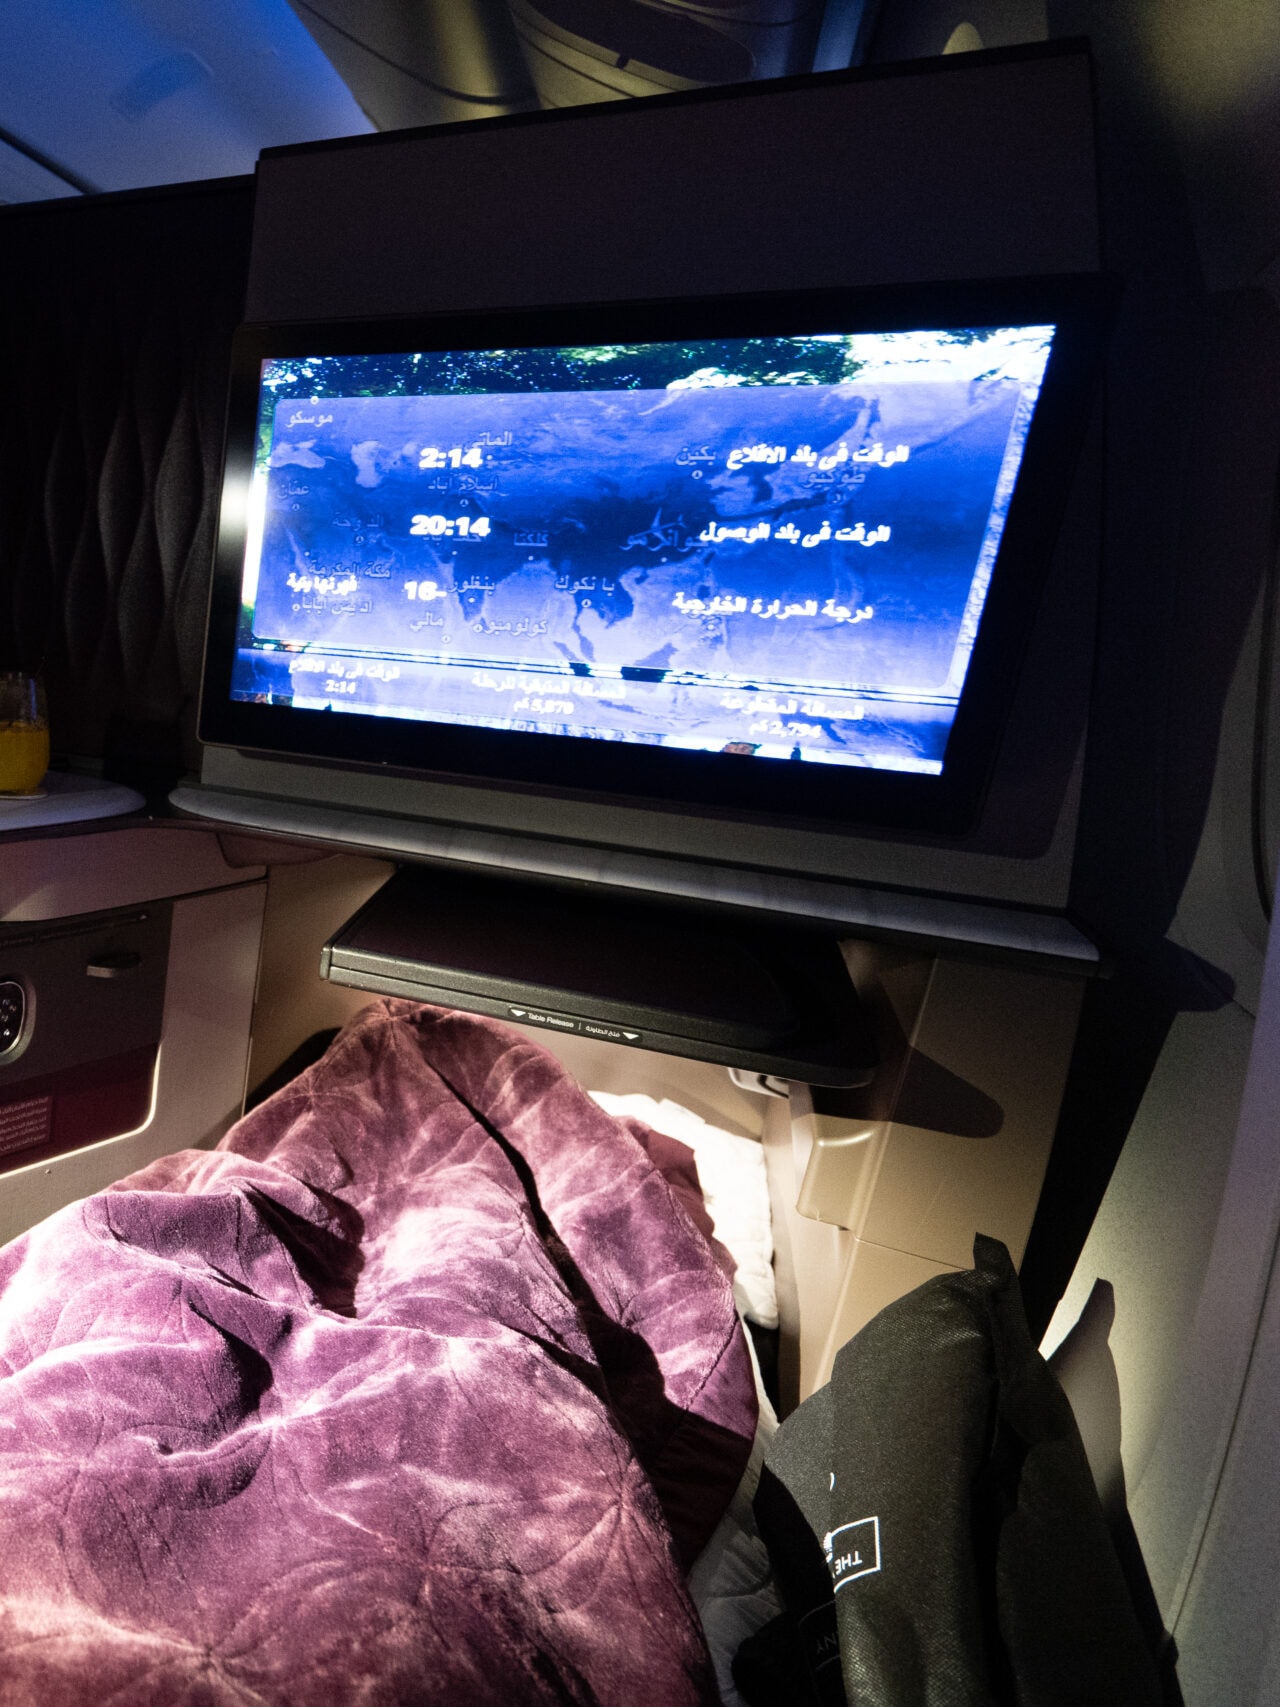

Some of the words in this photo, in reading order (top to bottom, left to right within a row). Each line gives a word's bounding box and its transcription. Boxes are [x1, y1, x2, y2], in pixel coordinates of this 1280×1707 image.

[285, 411, 333, 428] موسكو
[418, 447, 484, 468] 2:14
[790, 445, 818, 467] بلد
[852, 442, 910, 468] الوقت
[410, 514, 491, 537] 20:14
[699, 521, 771, 543] الوصول
[774, 522, 801, 545] بلد
[834, 522, 891, 547] الوقت
[750, 599, 818, 620] الحرارة
[820, 599, 874, 623] درجة
[324, 679, 357, 694] 2:14
[528, 1012, 546, 1022] Table
[834, 1550, 863, 1576] THE
